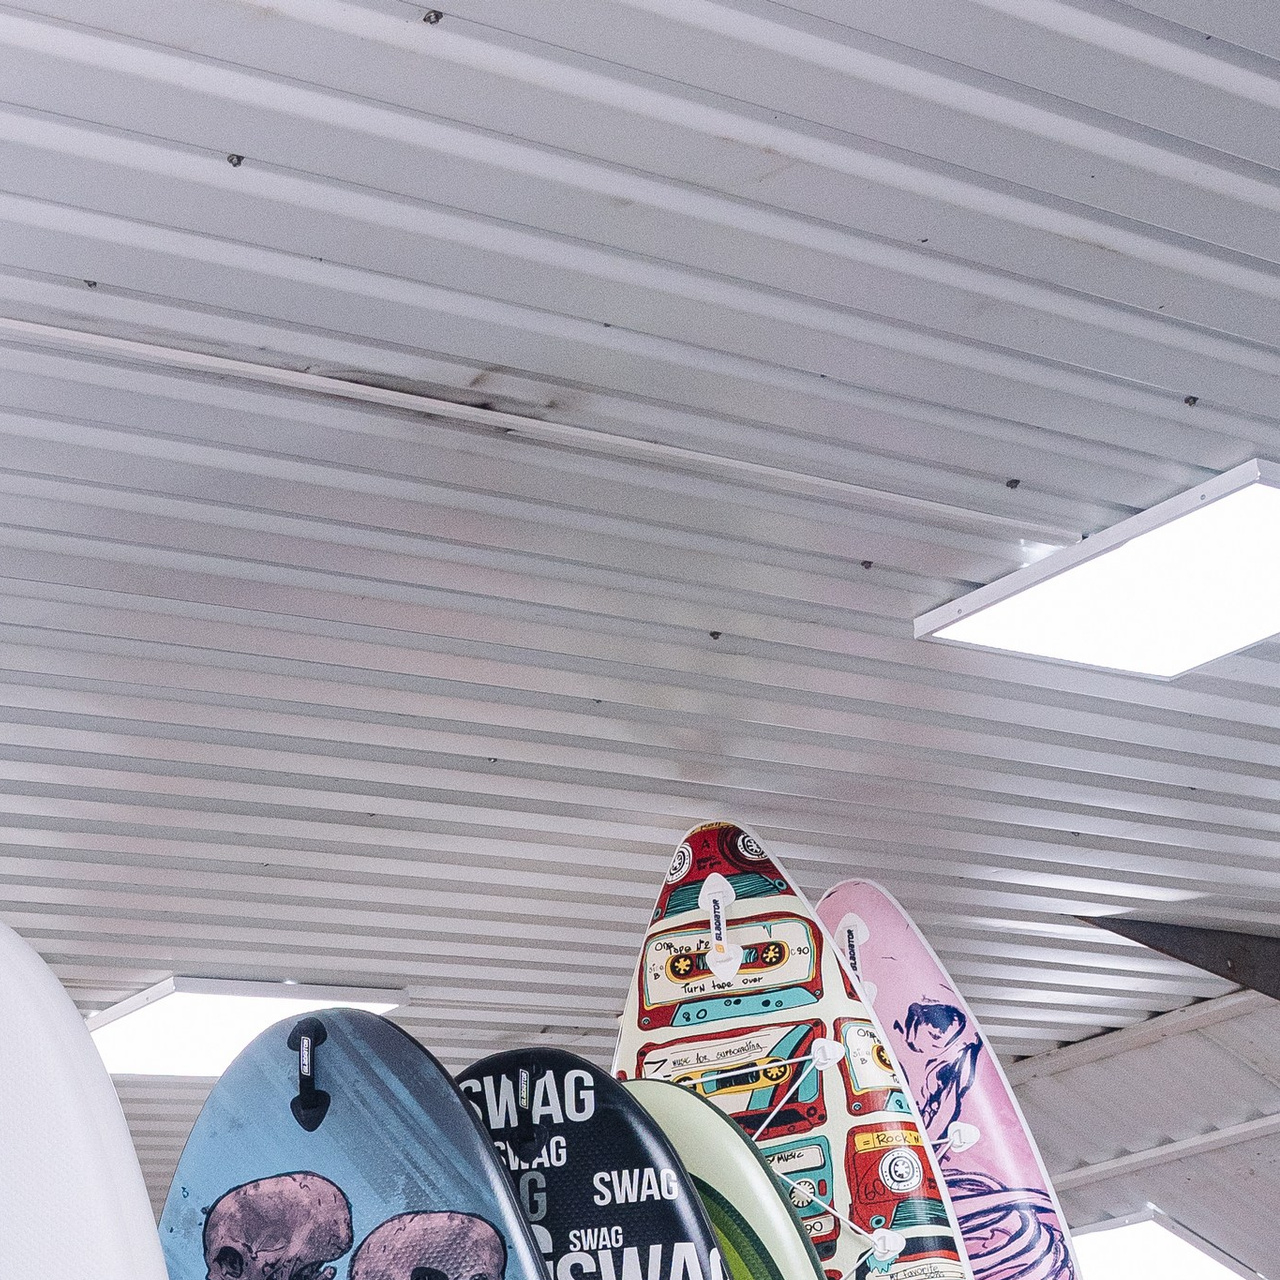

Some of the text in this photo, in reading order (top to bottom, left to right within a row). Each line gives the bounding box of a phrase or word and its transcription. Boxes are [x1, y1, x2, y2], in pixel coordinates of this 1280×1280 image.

[712, 899, 722, 941] GLADIATOR
[593, 1167, 680, 1206] SWAG
[569, 1226, 623, 1252] SWAG
